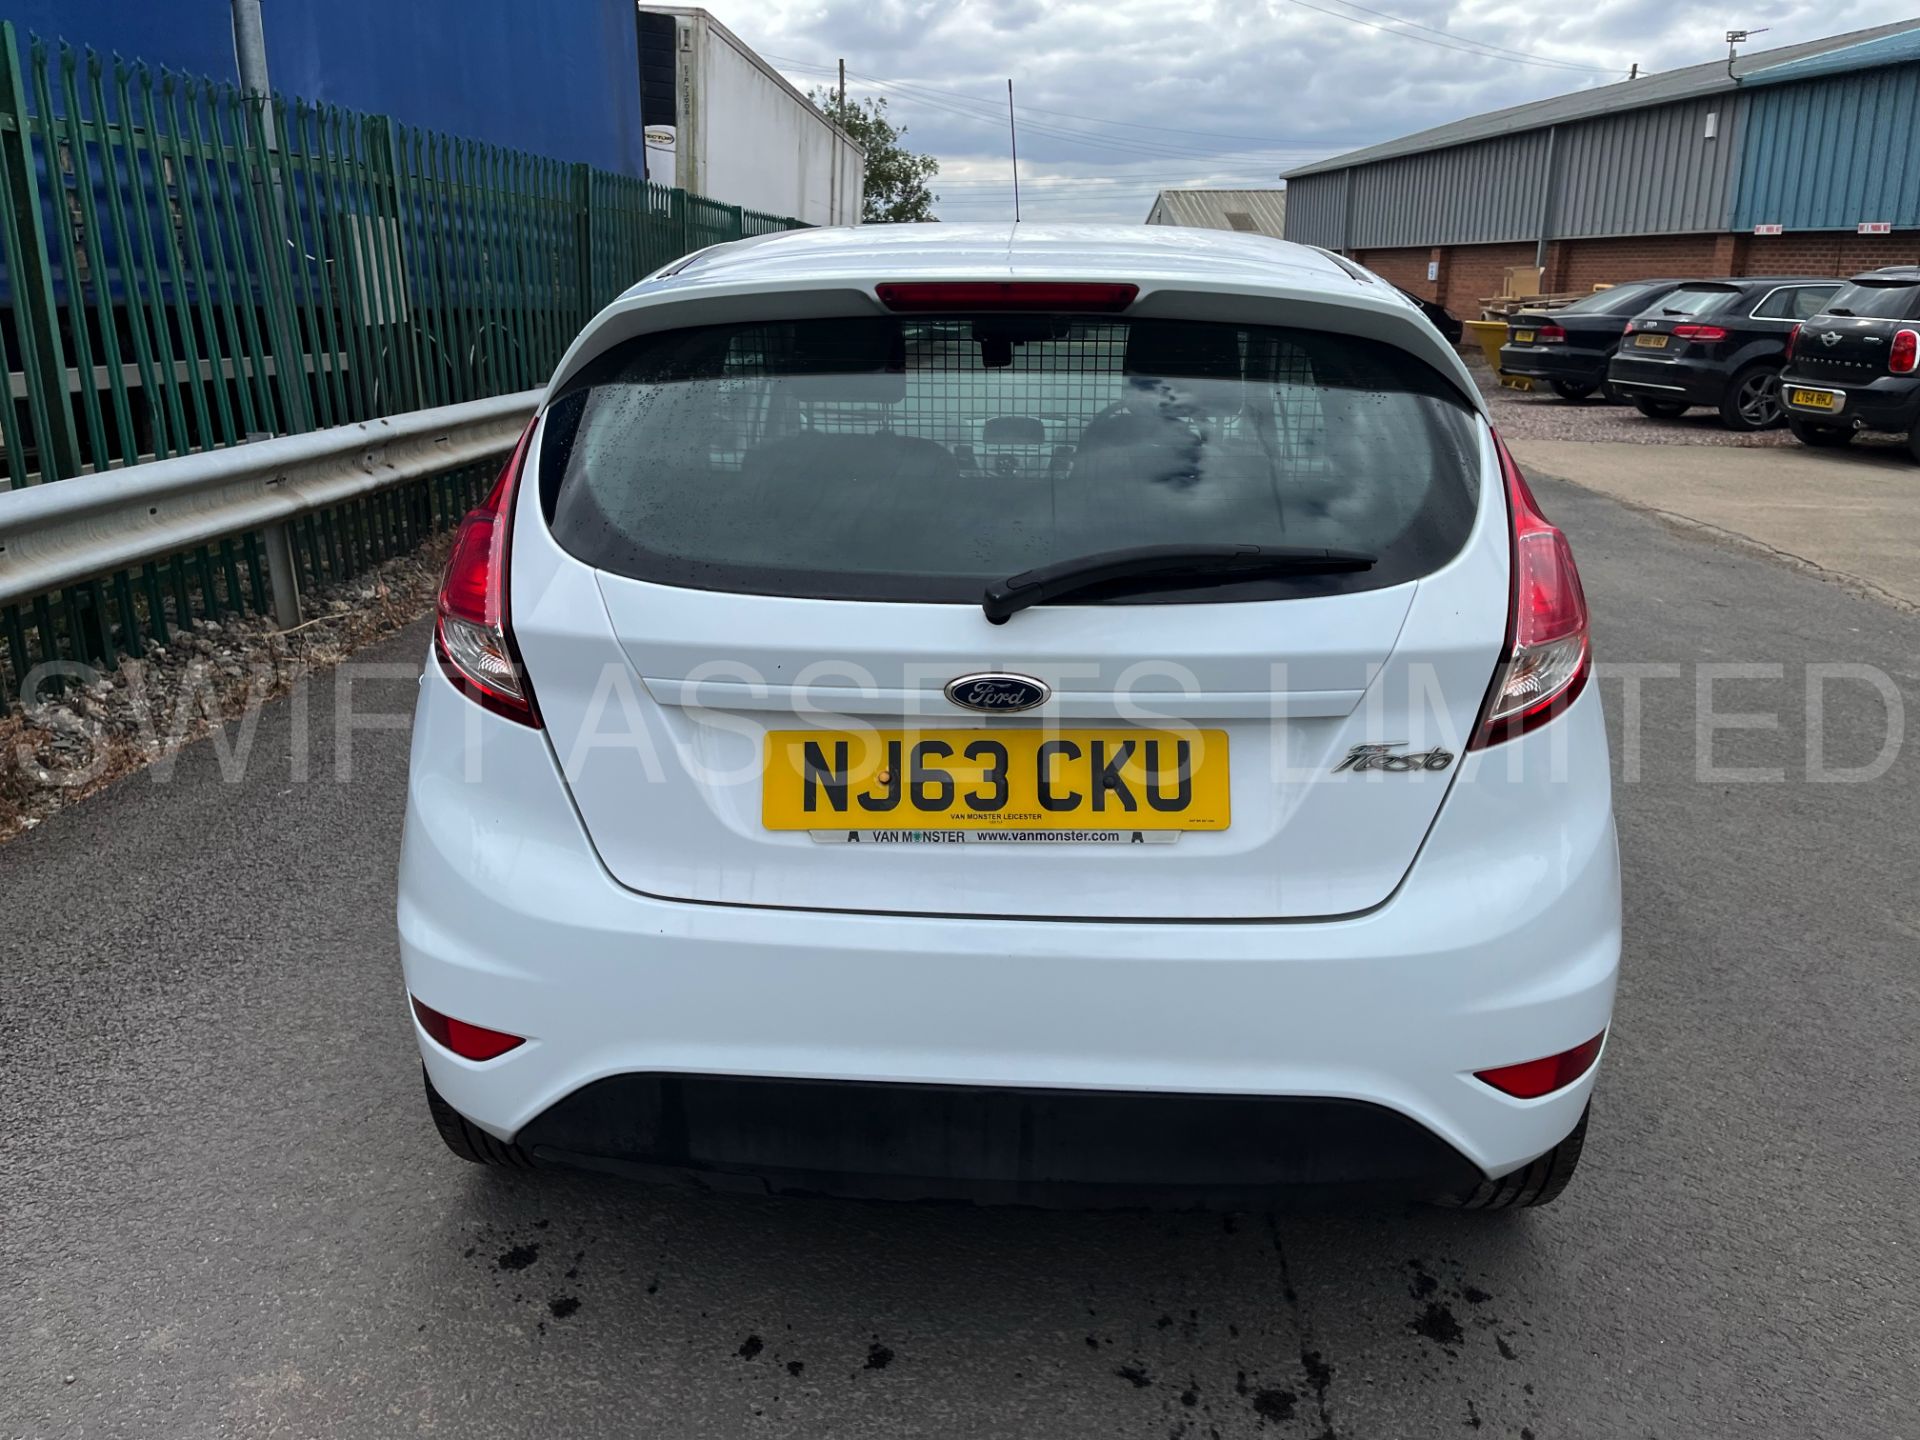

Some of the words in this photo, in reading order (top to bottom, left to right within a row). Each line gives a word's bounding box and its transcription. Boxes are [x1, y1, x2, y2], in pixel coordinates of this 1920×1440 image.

[645, 133, 673, 141] ECTOR
[968, 682, 1026, 705] Ford
[1331, 741, 1454, 773] Fiesta
[803, 740, 1009, 812] NJ63
[1037, 740, 1192, 812] CKU
[873, 831, 899, 842] VAN
[977, 831, 1119, 842] www.vanmonster.com
